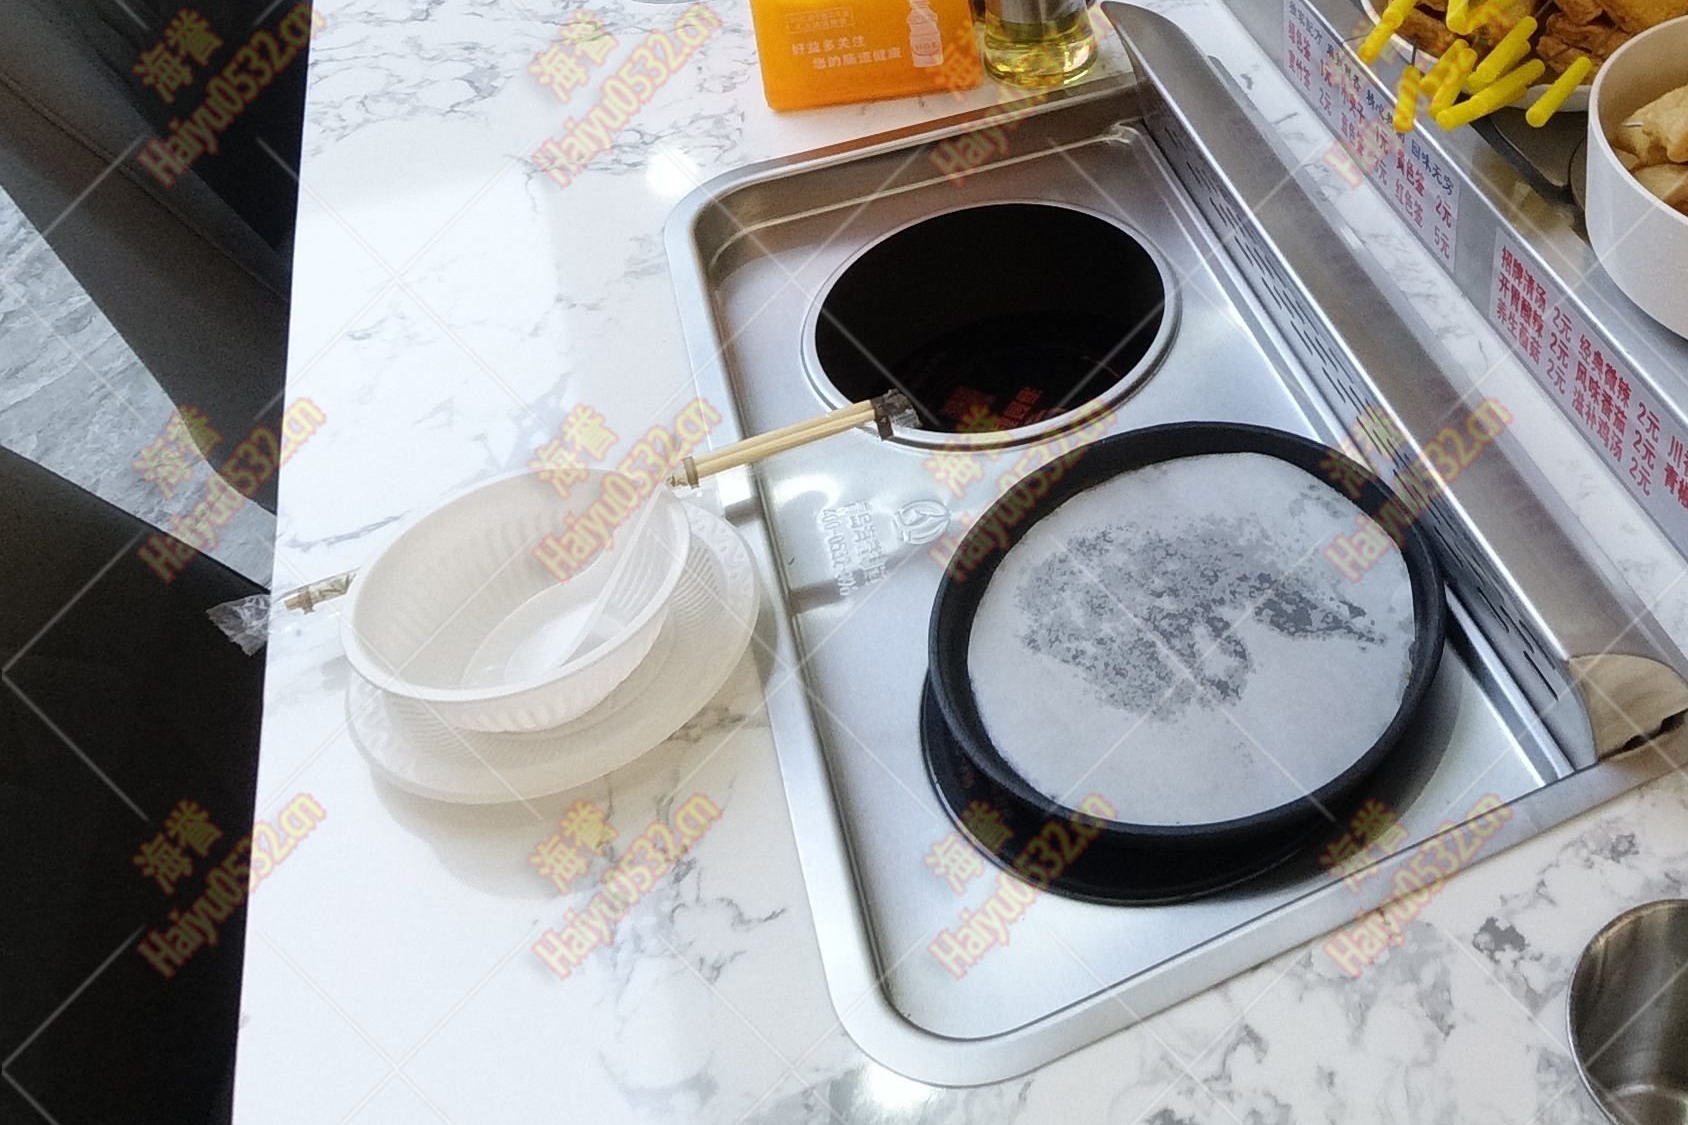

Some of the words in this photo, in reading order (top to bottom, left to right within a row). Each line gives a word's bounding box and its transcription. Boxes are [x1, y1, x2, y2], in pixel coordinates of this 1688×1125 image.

[1319, 87, 1332, 116] 2元
[1395, 180, 1423, 228] 红色签
[1434, 225, 1450, 260] 5元
[1411, 139, 1454, 195] 回味无穷
[1435, 194, 1452, 228] 2元
[1497, 297, 1541, 365] 养生菌菇
[1546, 358, 1567, 395] 2元
[1573, 388, 1623, 462] 滋补鸡汤
[1630, 456, 1652, 496] 2元
[1500, 273, 1544, 338] 开胃酸辣
[1549, 332, 1570, 370] 2元
[1575, 361, 1628, 435] 风味番茄
[1633, 430, 1656, 470] 2元
[1502, 245, 1546, 313] 招牌清汤
[1552, 306, 1573, 342] 2元
[1579, 334, 1632, 408] 经典微辣
[1638, 402, 1661, 443] 2元
